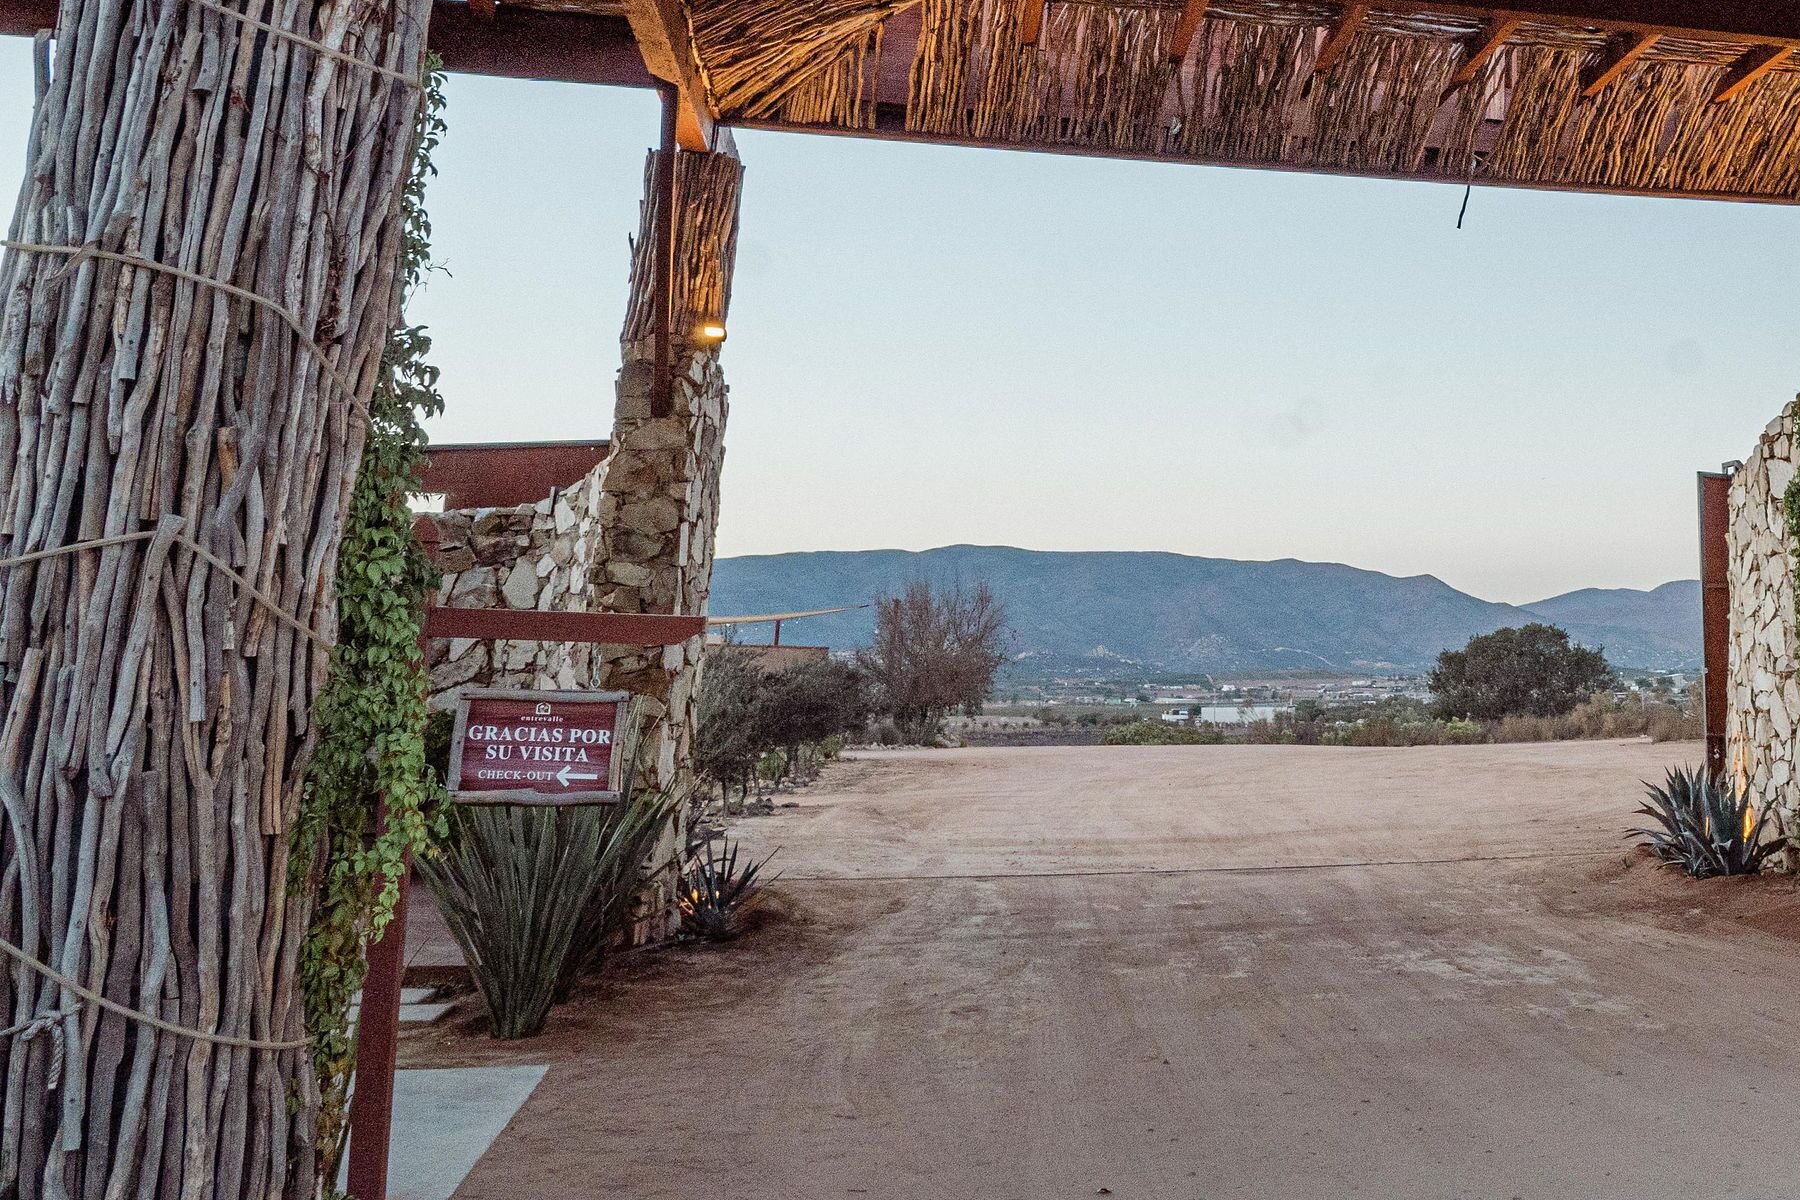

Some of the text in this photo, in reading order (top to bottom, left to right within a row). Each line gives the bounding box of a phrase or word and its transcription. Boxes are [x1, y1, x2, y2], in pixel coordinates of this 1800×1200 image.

[468, 725, 611, 744] GRACIAS POR
[485, 745, 589, 763] SU VISITA
[478, 769, 554, 781] CHECK-OUT
